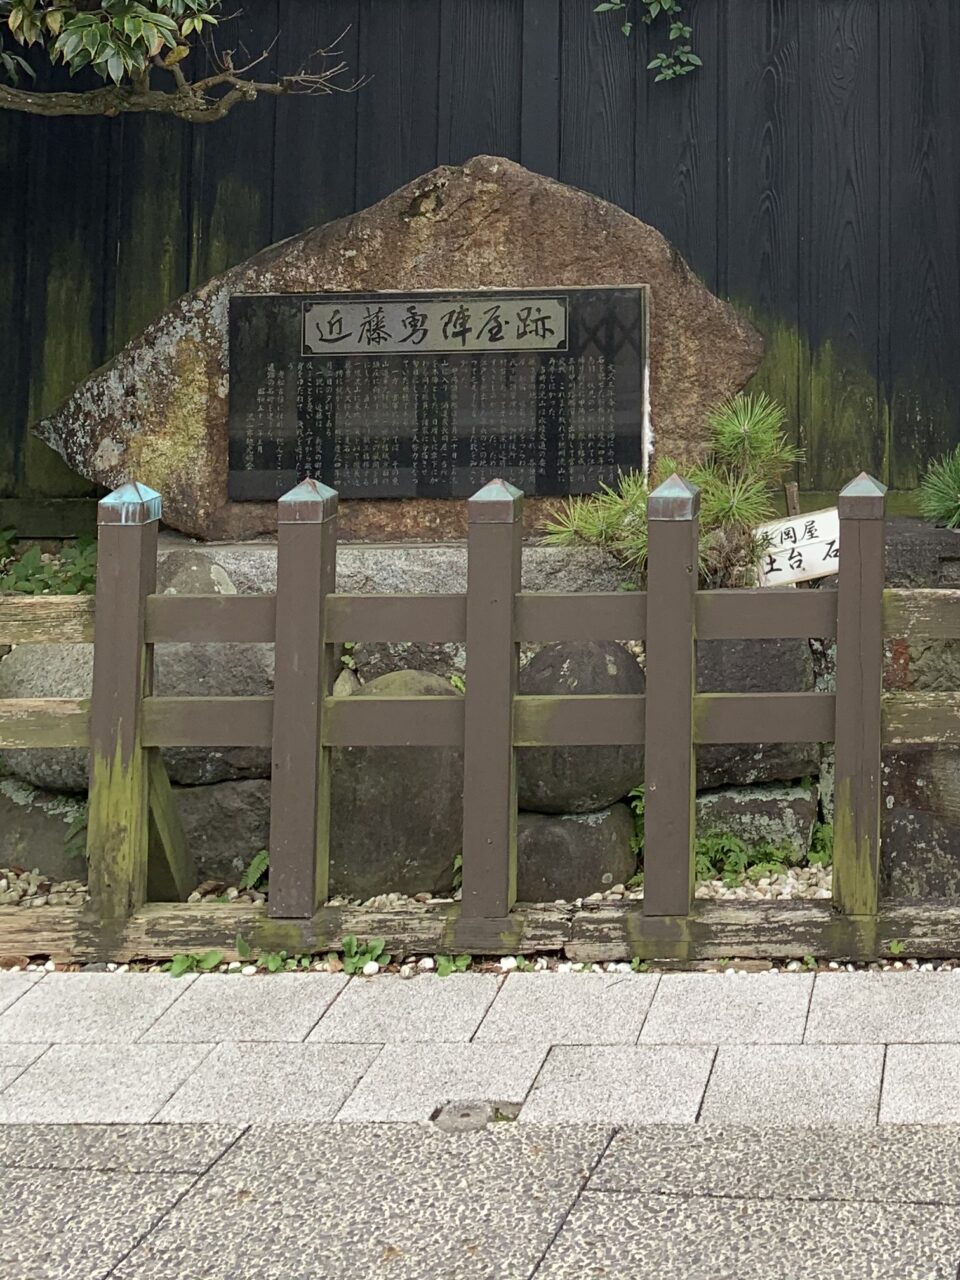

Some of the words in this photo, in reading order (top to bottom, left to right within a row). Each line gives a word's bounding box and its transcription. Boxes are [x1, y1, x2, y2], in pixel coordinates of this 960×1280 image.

[316, 304, 555, 346] 近藤勇陣屋跡
